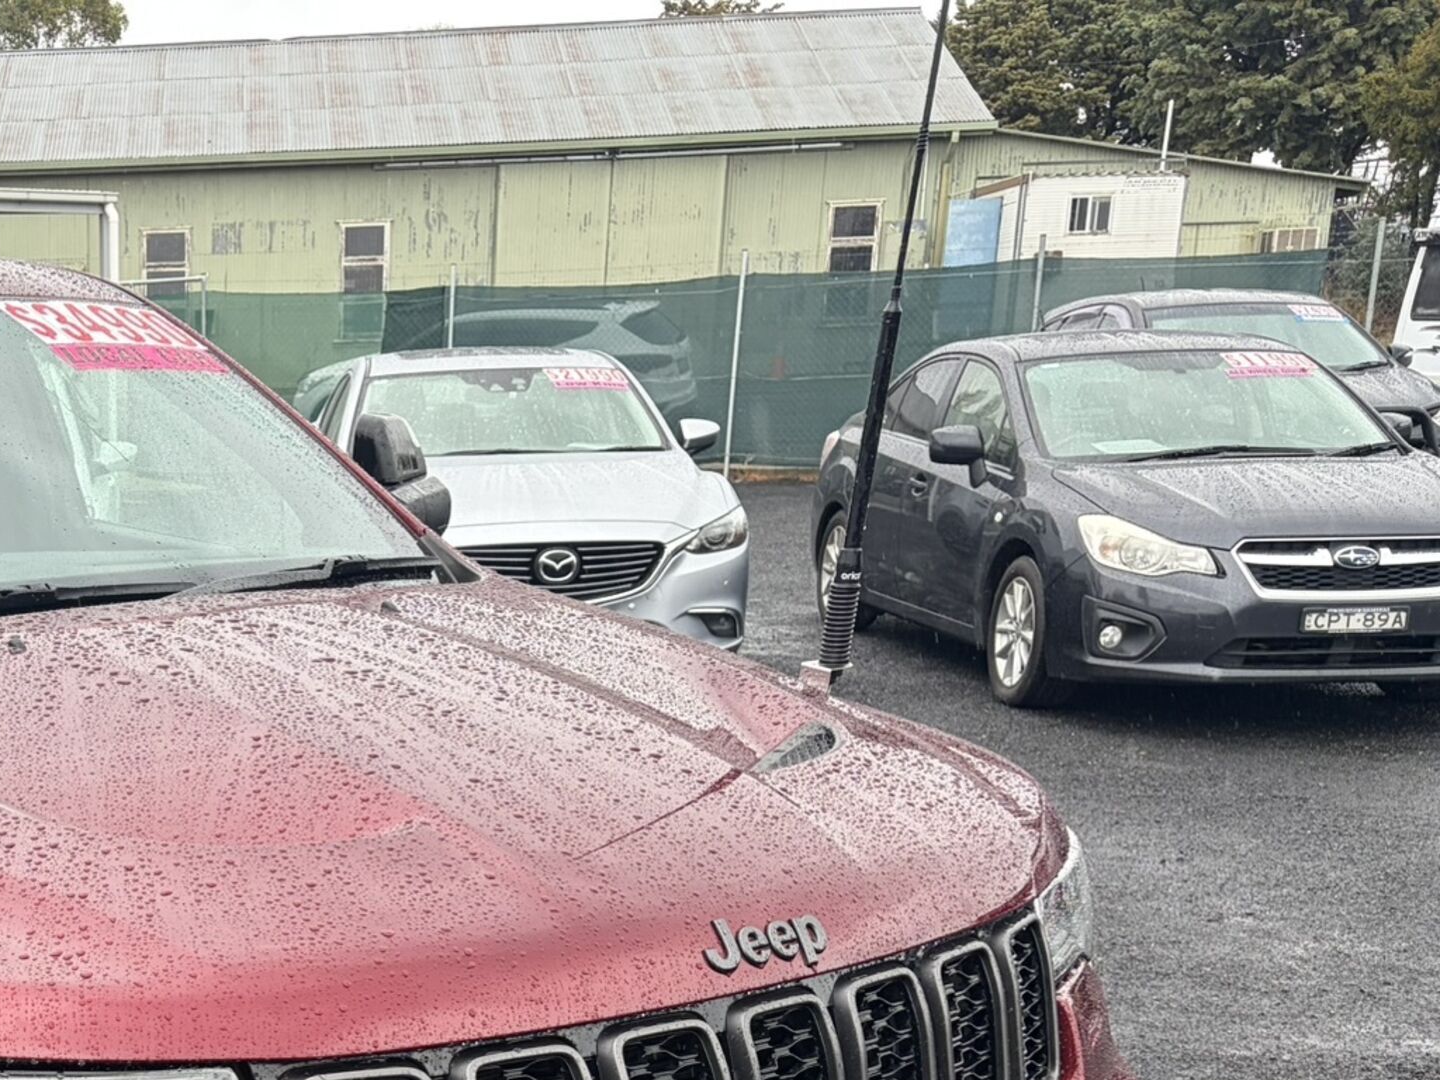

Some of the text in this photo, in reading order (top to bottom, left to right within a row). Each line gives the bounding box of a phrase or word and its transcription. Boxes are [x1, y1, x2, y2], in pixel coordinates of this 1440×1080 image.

[5, 303, 198, 348] $34990
[59, 346, 146, 364] LOCAL
[702, 914, 827, 973] Jeep
